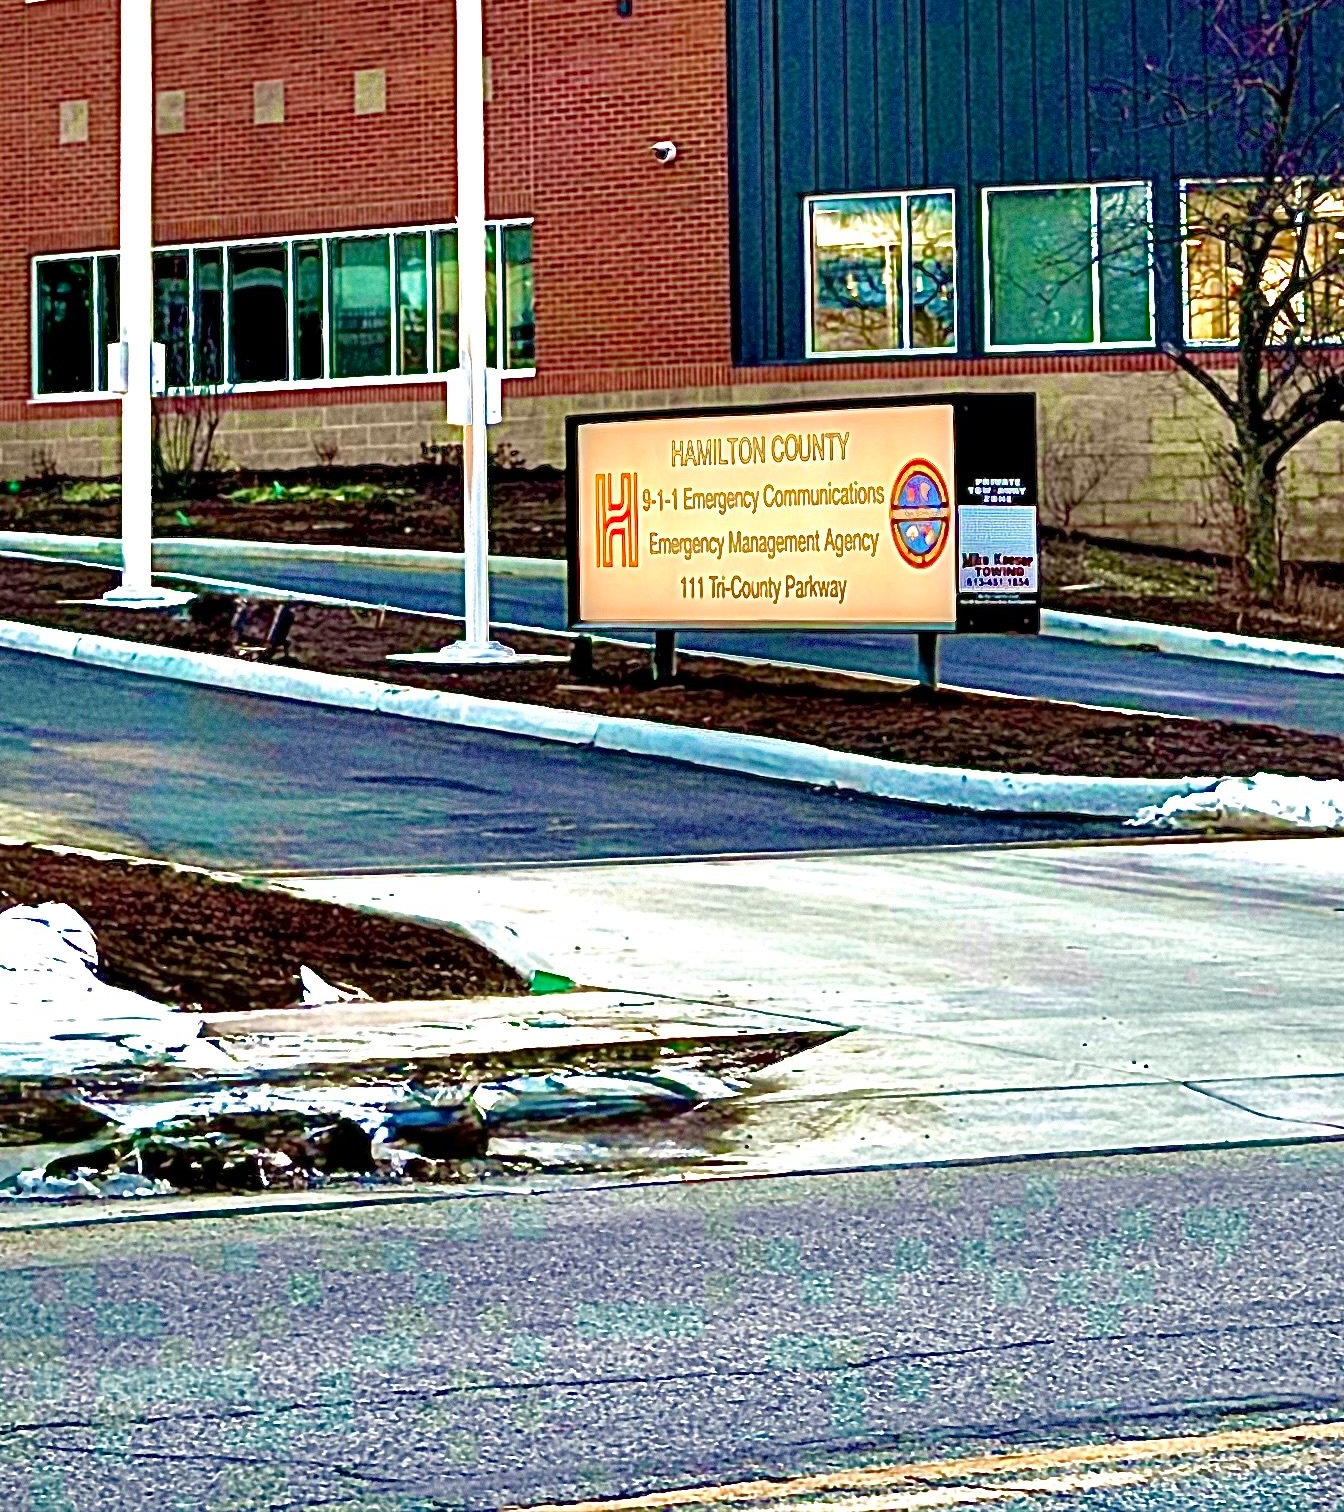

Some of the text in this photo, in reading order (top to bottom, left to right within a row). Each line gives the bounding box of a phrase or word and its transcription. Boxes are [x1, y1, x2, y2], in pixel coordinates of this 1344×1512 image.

[671, 431, 850, 467] HAMILTON COUNTY
[642, 480, 885, 515] 9-1-1 Emergency Communications
[649, 527, 880, 560] Emergency Management Agency
[974, 567, 1025, 577] TOWING
[680, 574, 847, 604] 111 Tri-County Parkway
